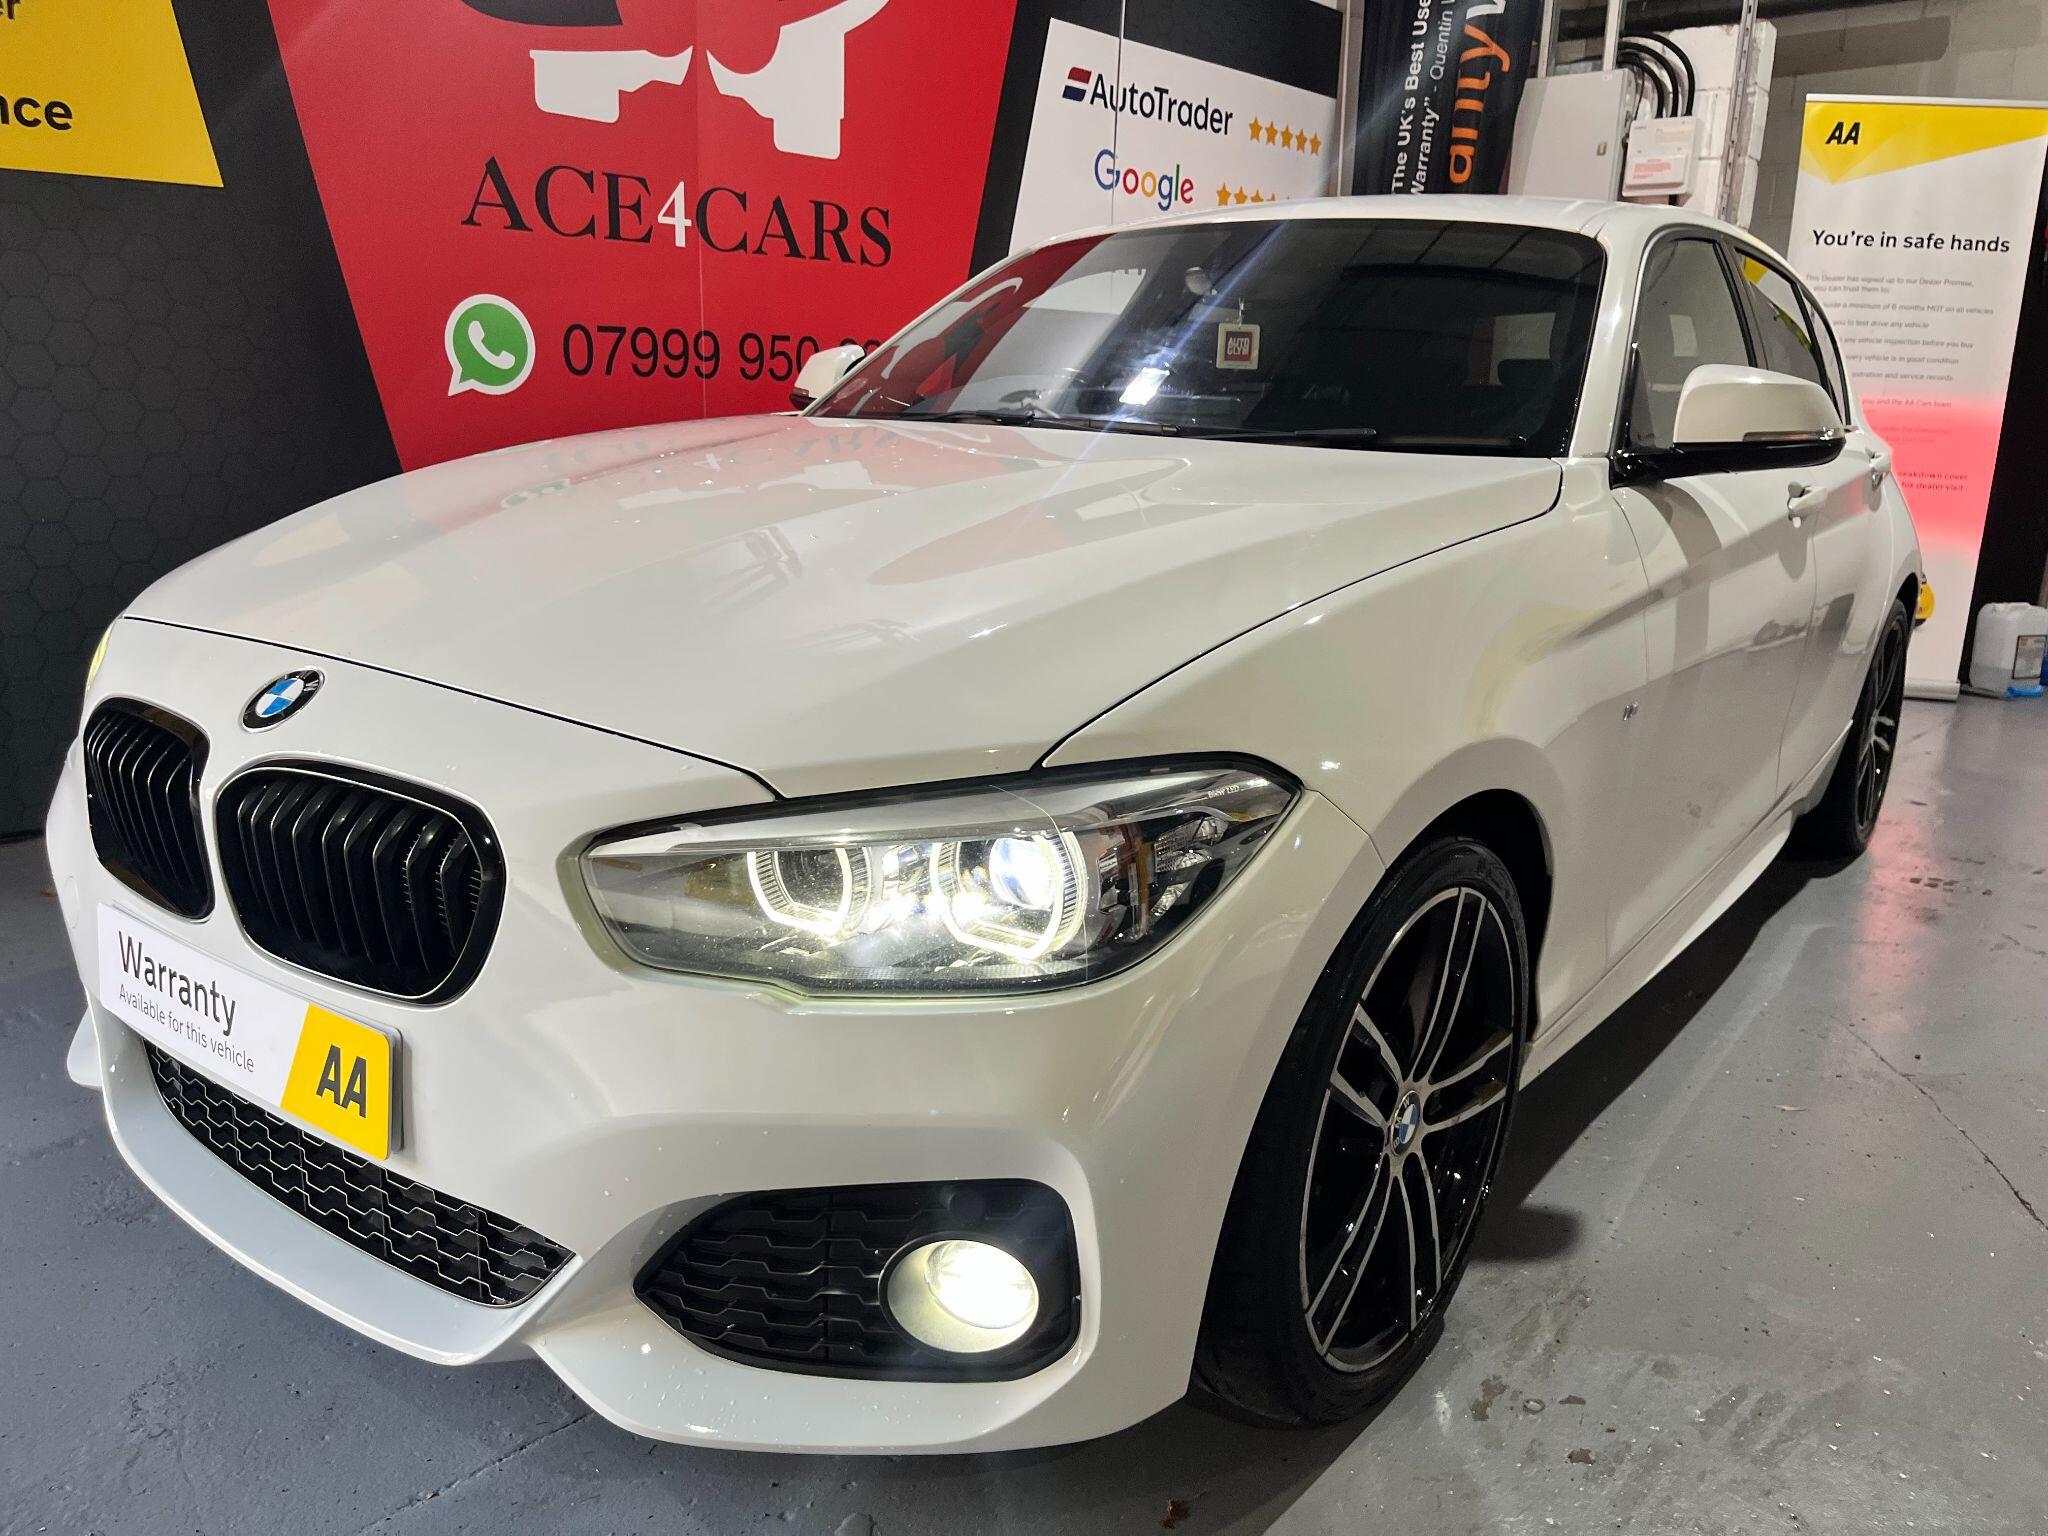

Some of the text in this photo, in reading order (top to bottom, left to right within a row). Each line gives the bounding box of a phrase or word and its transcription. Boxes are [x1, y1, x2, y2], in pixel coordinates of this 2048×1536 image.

[1404, 42, 1425, 90] Best
[1429, 10, 1453, 80] Quentin
[1090, 73, 1233, 135] AutoTrader
[1397, 97, 1416, 146] UK's
[1825, 121, 1861, 145] AA
[1094, 149, 1194, 212] Google
[1391, 152, 1408, 194] The
[460, 155, 893, 268] ACE4CARS
[1813, 229, 2011, 253] You're in safe hands
[563, 323, 720, 380] 07999
[118, 930, 237, 1037] Warranty
[119, 983, 255, 1074] Available for this vehicle
[316, 1044, 367, 1119] AA
